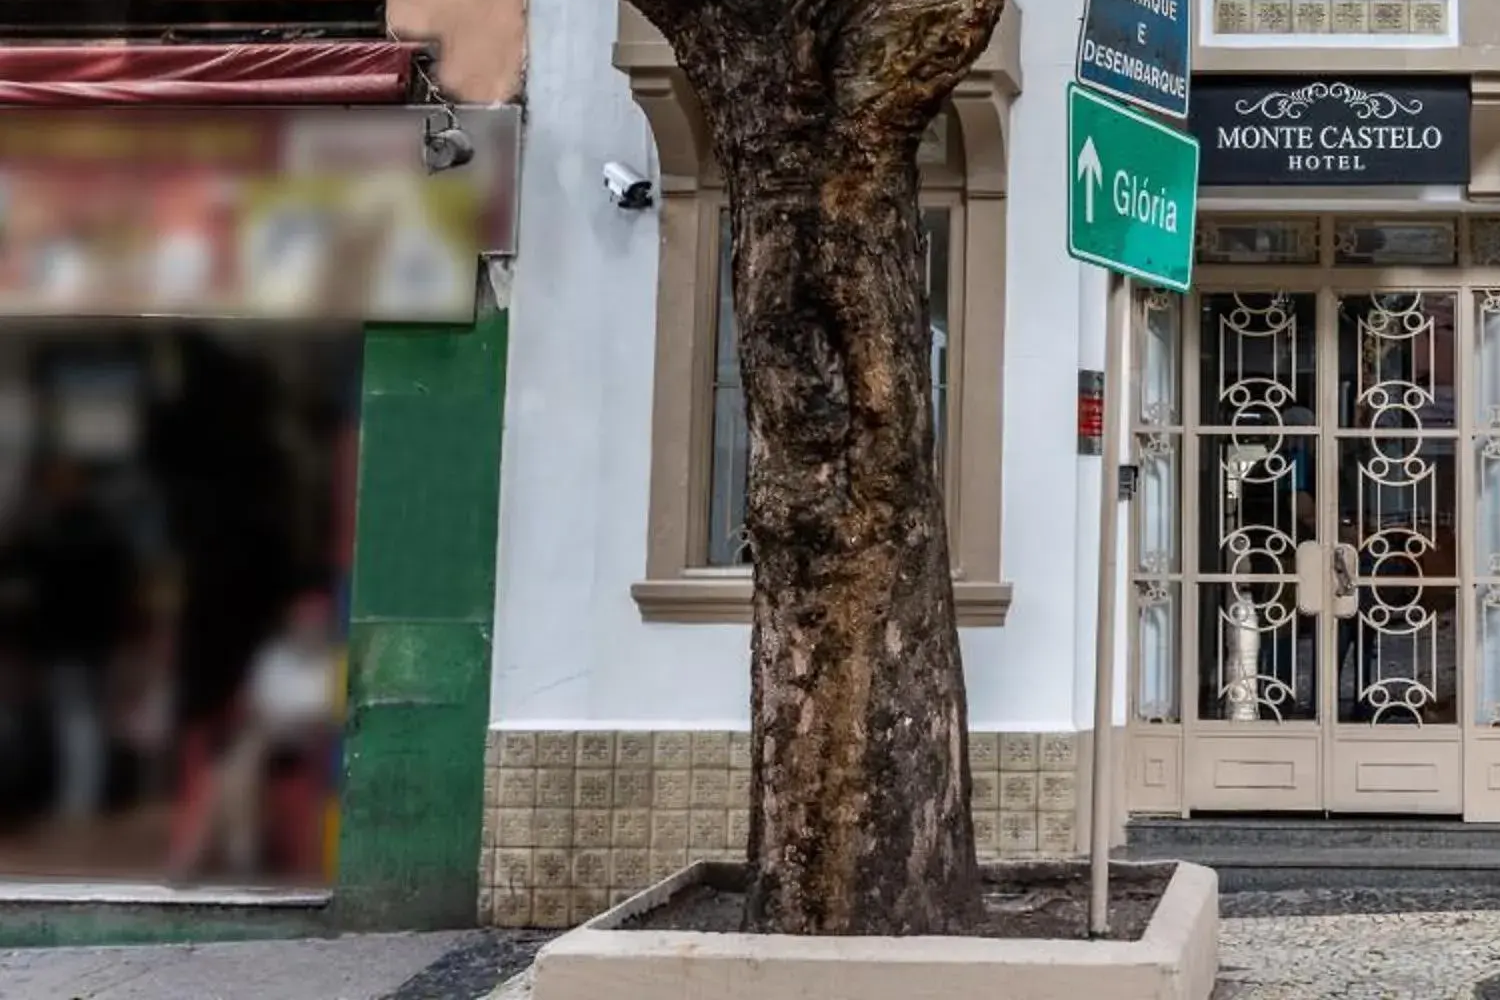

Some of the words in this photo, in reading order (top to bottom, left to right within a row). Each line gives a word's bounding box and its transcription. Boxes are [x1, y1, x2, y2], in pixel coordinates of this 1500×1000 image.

[1137, 23, 1146, 45] E
[1083, 39, 1186, 99] DESEMBARQUE
[1217, 126, 1313, 149] MONTE
[1319, 125, 1442, 150] CASTELO
[1288, 155, 1366, 170] HOTEL
[1113, 169, 1178, 233] Glória
